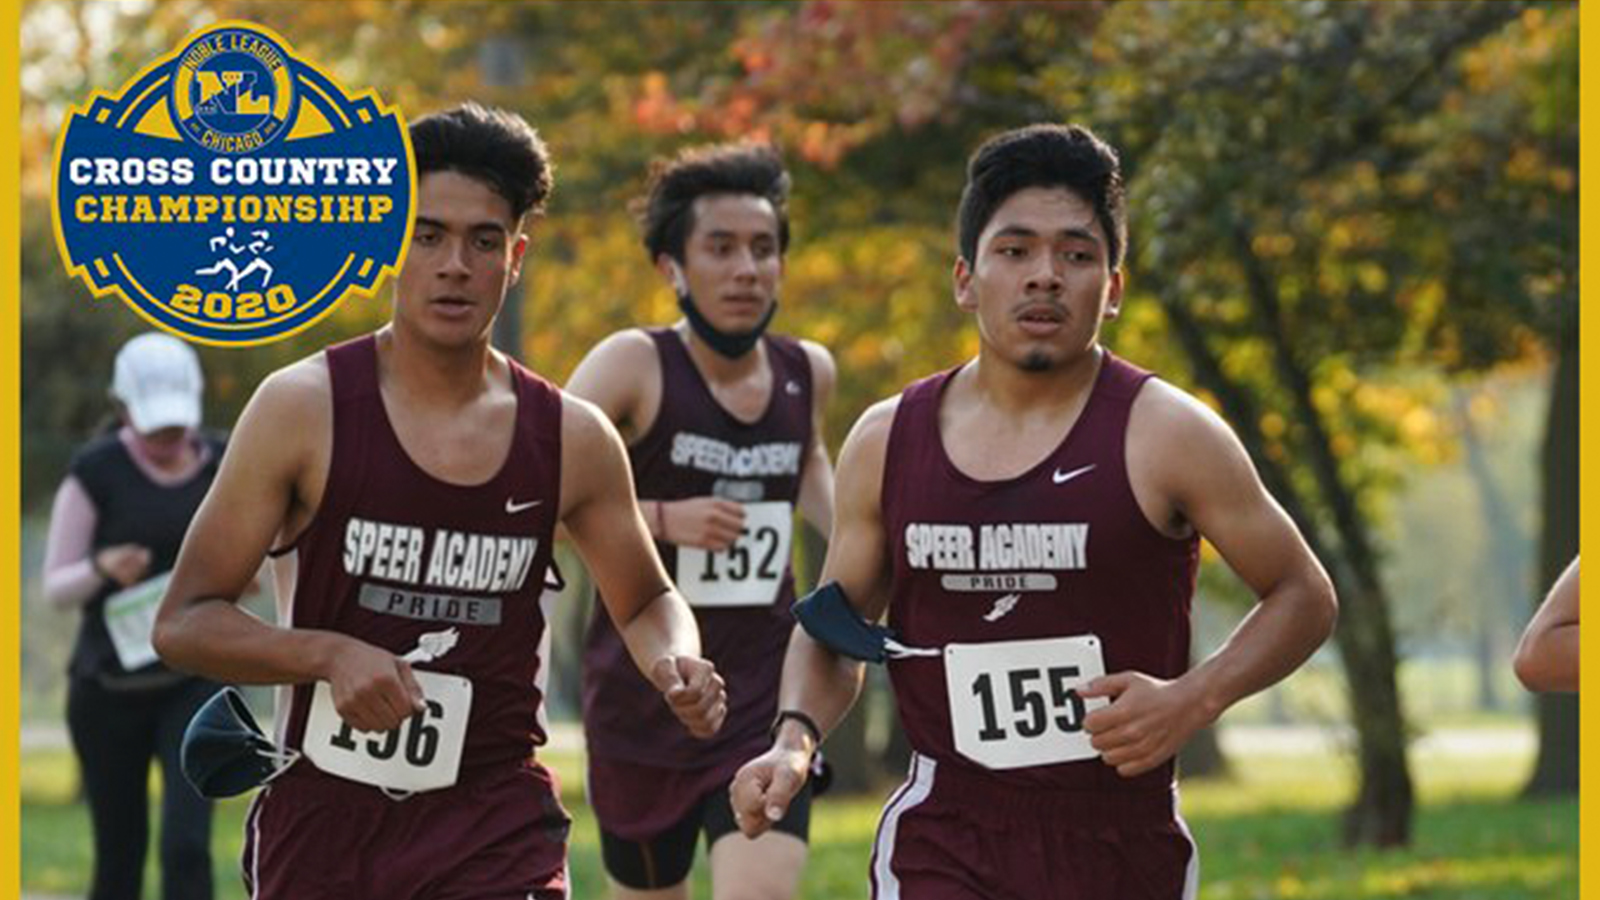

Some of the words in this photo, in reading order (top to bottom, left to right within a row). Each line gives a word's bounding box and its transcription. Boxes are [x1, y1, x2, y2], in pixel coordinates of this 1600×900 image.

[671, 431, 732, 475] SPEER
[343, 517, 424, 584] SPEER
[425, 529, 539, 593] ACADEMY
[700, 526, 779, 581] 152
[905, 522, 976, 570] SPEER
[979, 522, 1090, 570] ACADEMY
[387, 592, 480, 621] PRIDE
[970, 576, 1029, 589] PRIDE
[972, 665, 1087, 742] 155
